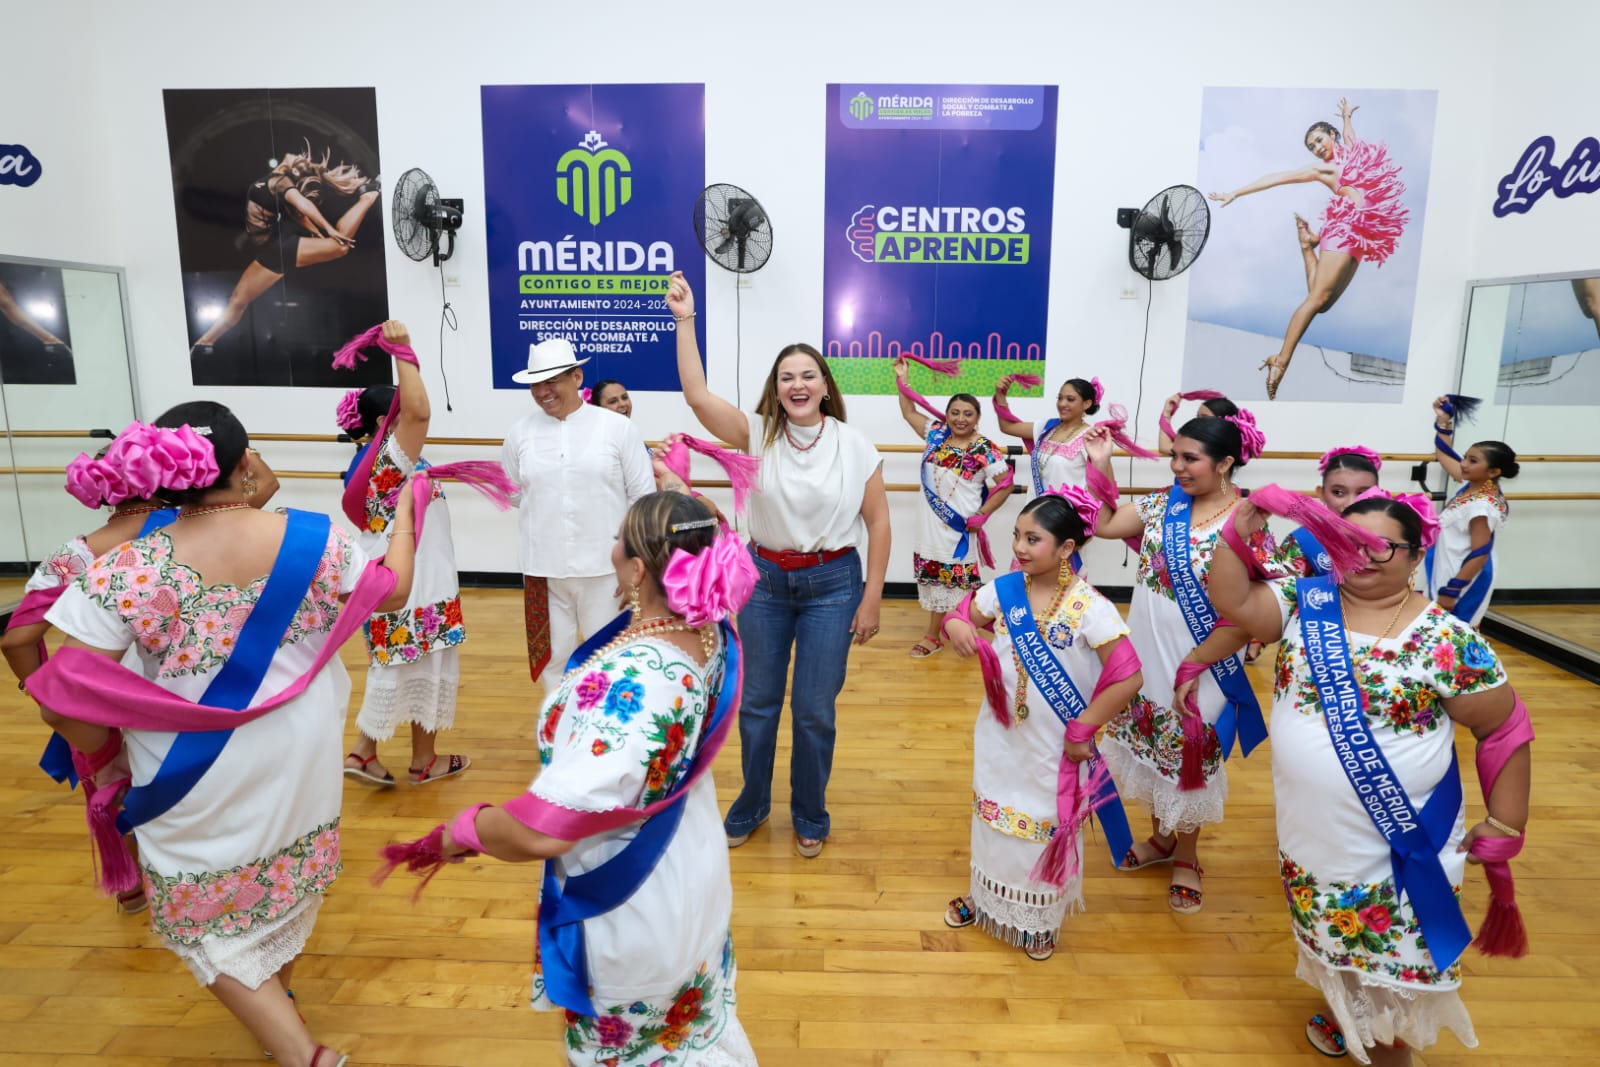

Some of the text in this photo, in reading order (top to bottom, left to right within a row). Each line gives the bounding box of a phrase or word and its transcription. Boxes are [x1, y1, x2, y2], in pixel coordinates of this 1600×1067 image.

[878, 94, 933, 108] MÉRIDA
[877, 206, 1025, 233] CENTROS
[518, 234, 674, 271] MÉRIDA
[879, 237, 1023, 262] APRENDE
[524, 279, 669, 292] CONTIGO ES MEJOR
[520, 300, 670, 310] AYUNTAMIENTO 2024-202
[520, 318, 676, 331] DIRECCIÓN DE DESARROLLO
[537, 332, 658, 342] SOCIAL Y COMBATE A
[580, 343, 632, 353] POBREZA
[1165, 522, 1176, 571] DIRECCIÓN
[1171, 572, 1180, 585] DE
[1176, 587, 1206, 643] DESARROLL
[1175, 522, 1216, 632] AYUNTAMIENTO DE
[1015, 635, 1059, 702] DIRECCIÓN DE
[1024, 631, 1085, 714] AYUNTAMIENT
[1305, 621, 1396, 840] DIRECCIÓN DE DESARROLLO SOCIAL
[1322, 621, 1418, 833] AYUNTAMIENTO DE MÉRIDA
